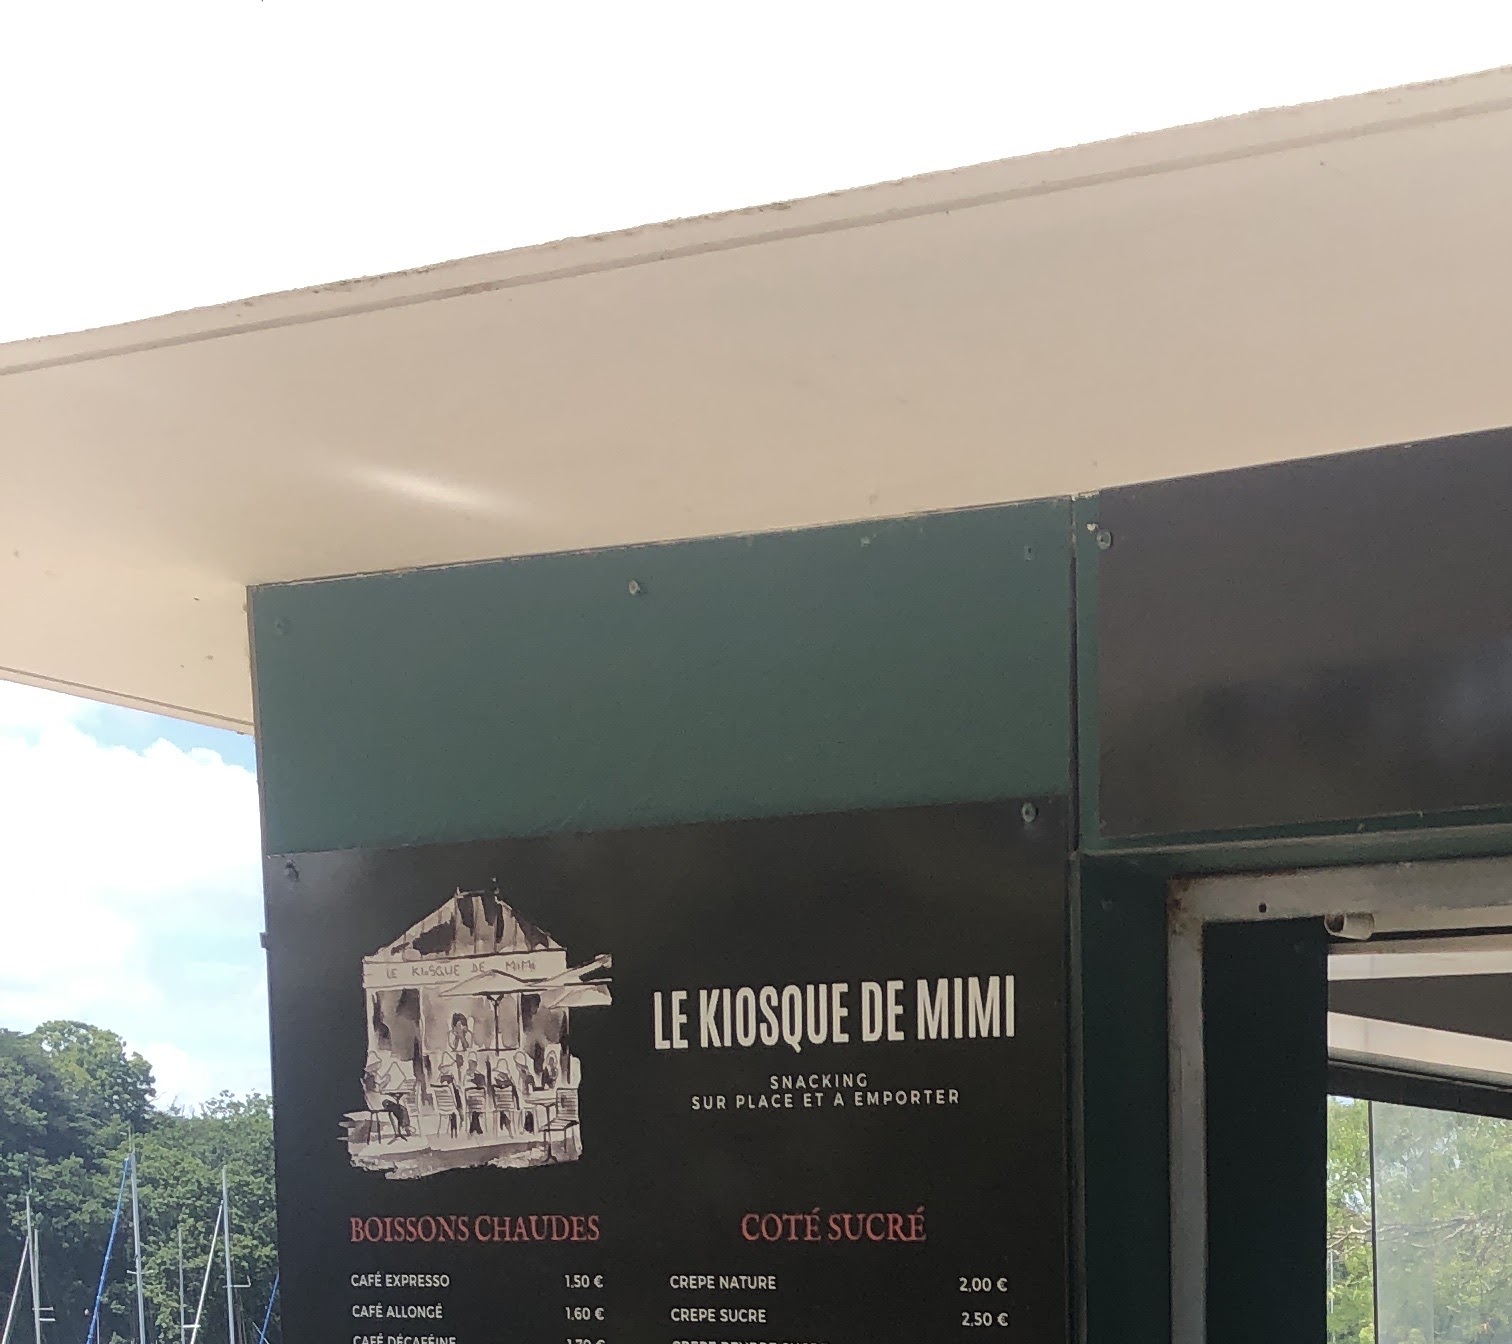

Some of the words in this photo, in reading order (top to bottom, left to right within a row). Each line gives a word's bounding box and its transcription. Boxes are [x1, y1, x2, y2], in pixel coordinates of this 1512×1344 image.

[386, 967, 398, 979] LE
[470, 961, 485, 973] DE
[654, 990, 688, 1049] LE
[699, 983, 849, 1053] KIOSQUE
[861, 980, 904, 1042] DE
[917, 975, 1014, 1040] MIMI
[770, 1073, 867, 1089] SNACKING
[692, 1096, 726, 1110] SUR
[736, 1094, 793, 1109] PLACE
[803, 1092, 823, 1107] ET
[834, 1092, 844, 1106] A
[855, 1089, 958, 1106] EMPORTER
[350, 1215, 469, 1242] BOISSONS
[474, 1215, 599, 1241] CHAUDES
[741, 1207, 821, 1241] COTÉ
[828, 1206, 926, 1241] SUCRÉ
[351, 1271, 382, 1287] CAFÉ
[385, 1274, 450, 1287] EXPRESSO
[594, 1275, 603, 1288] €
[670, 1275, 715, 1289] CREPE
[719, 1276, 776, 1289] NATURE
[997, 1278, 1007, 1292] €
[352, 1303, 383, 1318] CAFÉ
[386, 1303, 443, 1318] ALLONGÉ
[595, 1307, 604, 1320] €
